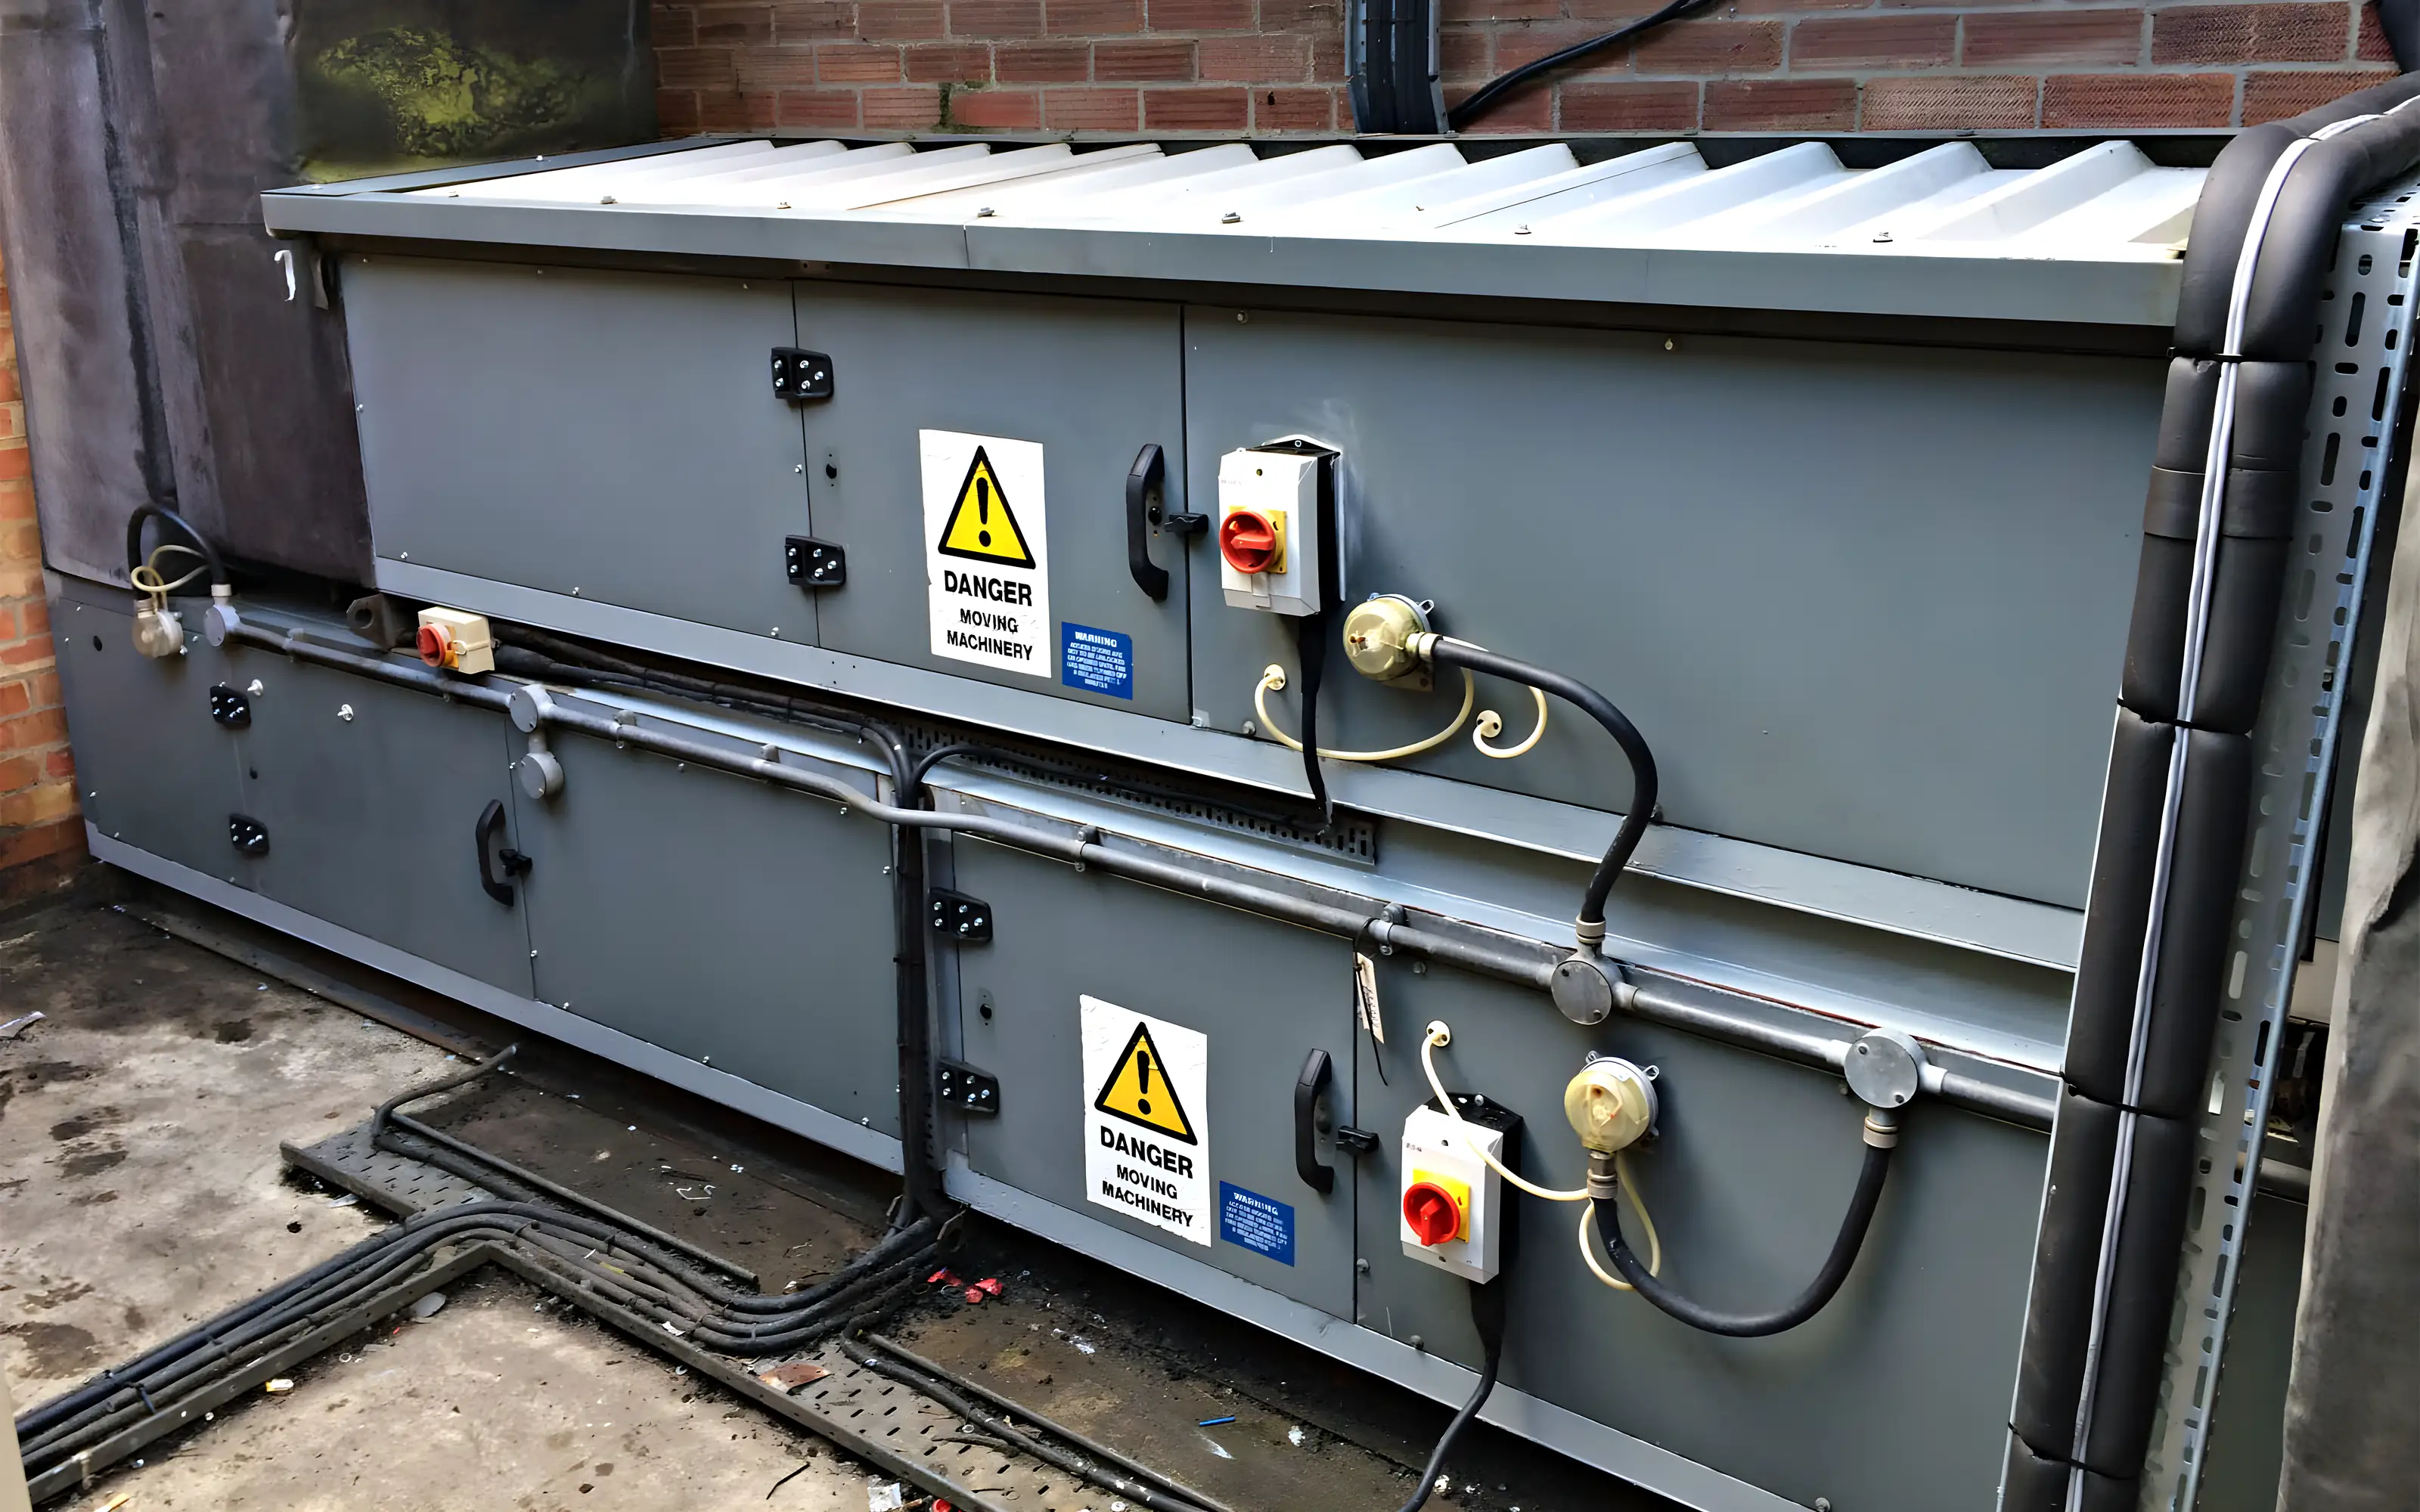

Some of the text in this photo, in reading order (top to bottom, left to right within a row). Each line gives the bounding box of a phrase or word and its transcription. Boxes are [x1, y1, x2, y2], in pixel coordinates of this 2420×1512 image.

[944, 570, 1032, 606] DANGER
[960, 608, 1019, 634] MOVING
[947, 630, 1033, 661] MACHINERY
[1100, 1125, 1193, 1179] DANGER
[1116, 1164, 1177, 1200] MOVING
[1102, 1180, 1193, 1227] MACHINERY
